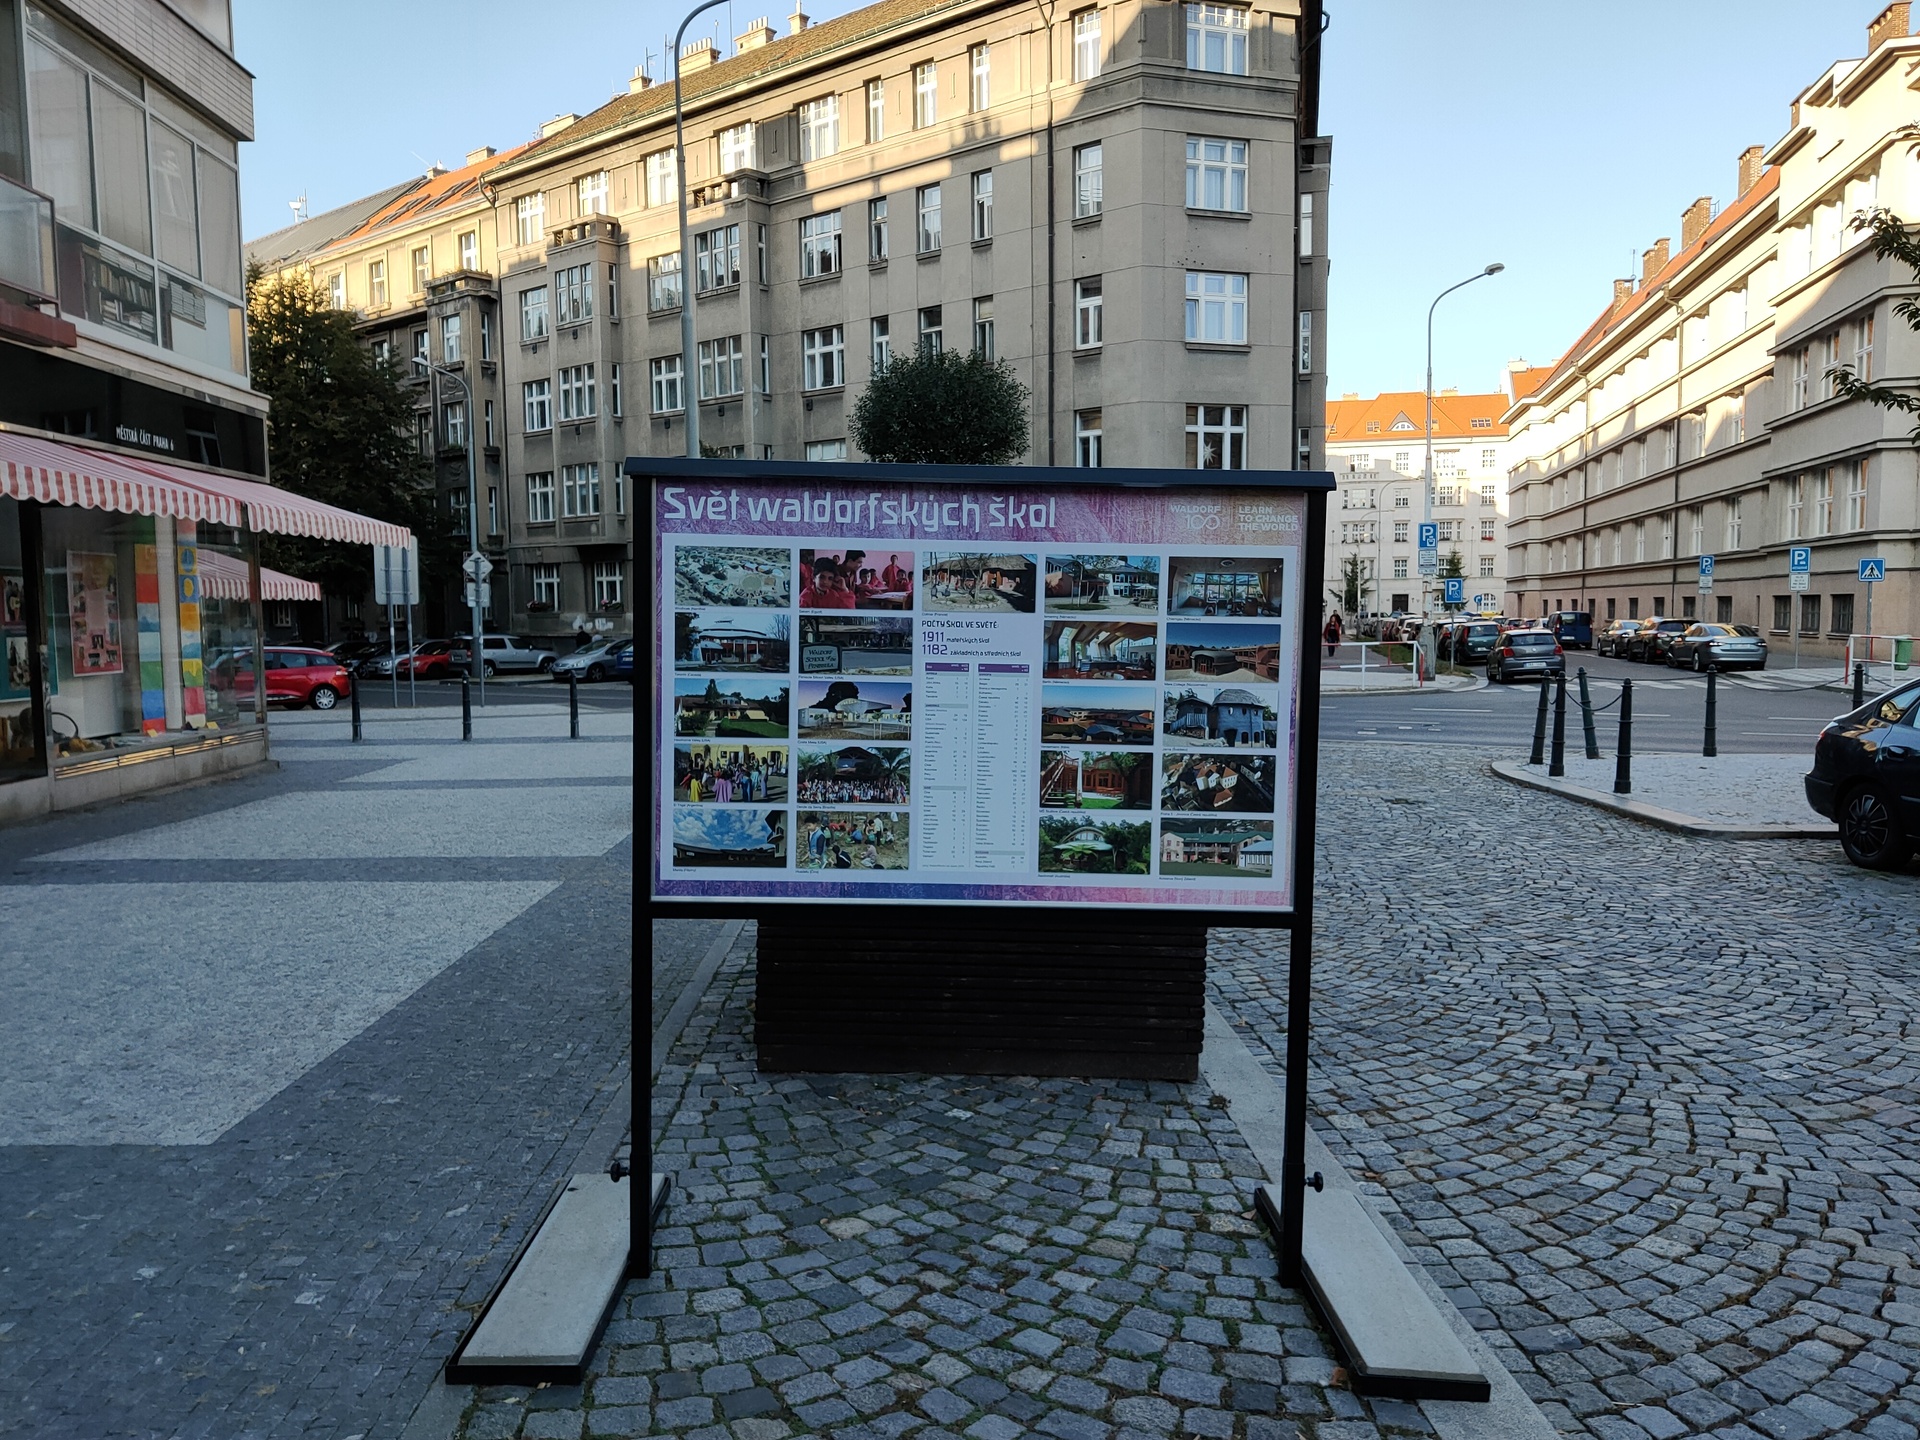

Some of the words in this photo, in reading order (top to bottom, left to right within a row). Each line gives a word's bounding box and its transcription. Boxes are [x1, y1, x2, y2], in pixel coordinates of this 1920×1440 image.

[116, 424, 138, 443] MĚSTSKÁ
[140, 429, 151, 446] ČÁST
[153, 435, 169, 450] PRAHA
[170, 439, 174, 451] 6
[663, 486, 739, 521] Svět
[747, 490, 980, 533] waldorfských
[988, 495, 1056, 529] škol
[1170, 504, 1221, 513] WALDORF
[1239, 506, 1273, 514] LEARN
[1239, 514, 1253, 522] TO
[1255, 514, 1298, 523] CHANGE
[1239, 522, 1259, 530] THE
[1262, 522, 1298, 531] WORLD
[1422, 526, 1434, 541] P
[1794, 551, 1806, 565] P
[1448, 582, 1459, 595] P
[922, 620, 945, 628] POČTY
[946, 620, 964, 628] ŠKOL
[922, 631, 944, 642] 1911
[922, 644, 948, 655] 1182
